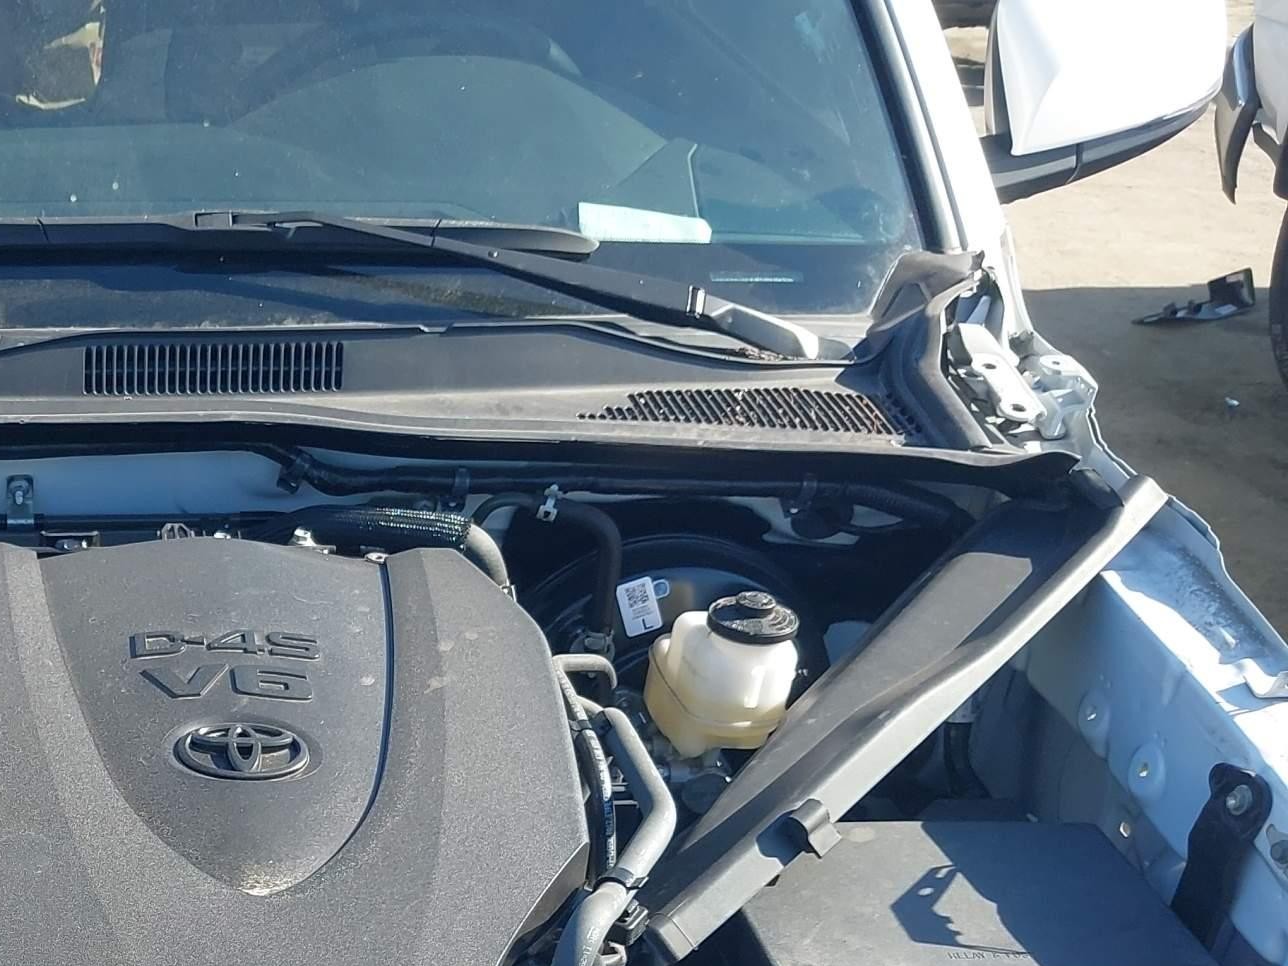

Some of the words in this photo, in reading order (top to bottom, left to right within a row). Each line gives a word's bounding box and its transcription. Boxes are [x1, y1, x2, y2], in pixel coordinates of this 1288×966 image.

[642, 618, 654, 630] L
[129, 629, 321, 662] D-4S
[139, 663, 313, 703] V6
